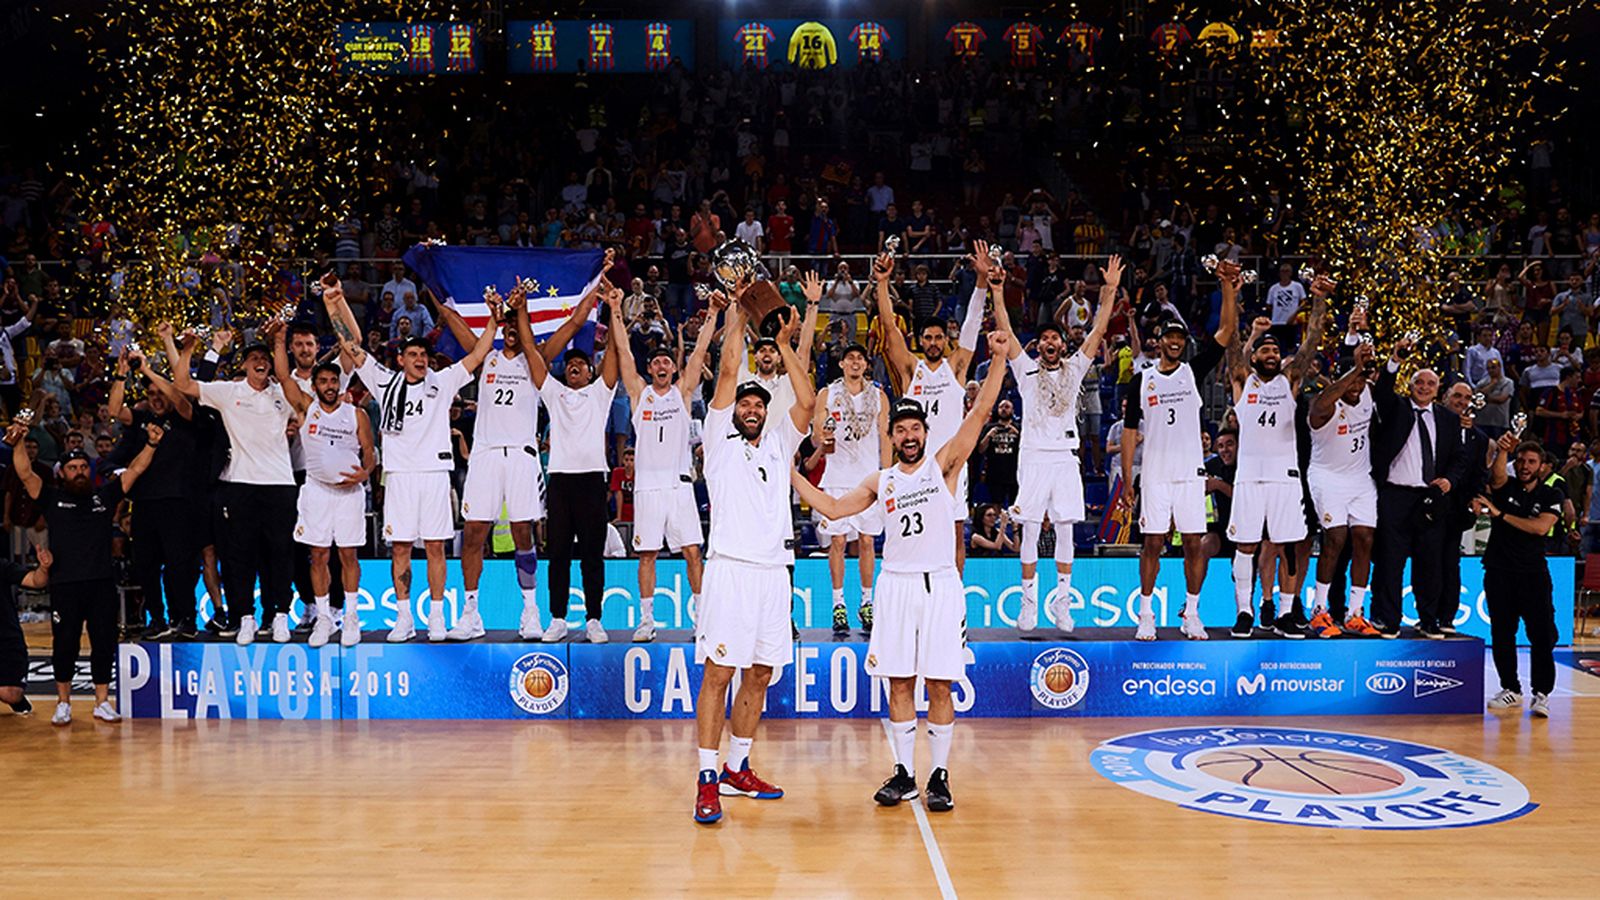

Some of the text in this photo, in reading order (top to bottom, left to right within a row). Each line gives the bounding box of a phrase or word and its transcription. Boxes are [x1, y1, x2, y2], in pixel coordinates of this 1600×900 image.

[451, 37, 471, 52] 12
[534, 36, 552, 51] 11
[595, 36, 606, 51] 7
[652, 36, 664, 51] 4
[745, 35, 764, 50] 21
[803, 35, 822, 50] 16
[859, 35, 880, 50] 14
[1018, 34, 1029, 49] 5
[494, 388, 514, 405] 22
[405, 400, 423, 416] 24
[1167, 408, 1175, 425] 3
[1258, 410, 1276, 427] 44
[900, 511, 924, 538] 23
[963, 572, 1168, 628] ndesa
[118, 643, 384, 720] PLAYOFF
[234, 671, 333, 697] ENDESA
[349, 671, 410, 697] 2019
[624, 646, 976, 713] CAEOS
[1122, 674, 1216, 696] endesa
[1270, 677, 1345, 692] movistar
[1372, 677, 1400, 690] KIA
[1194, 790, 1501, 822] PLAYOFF
